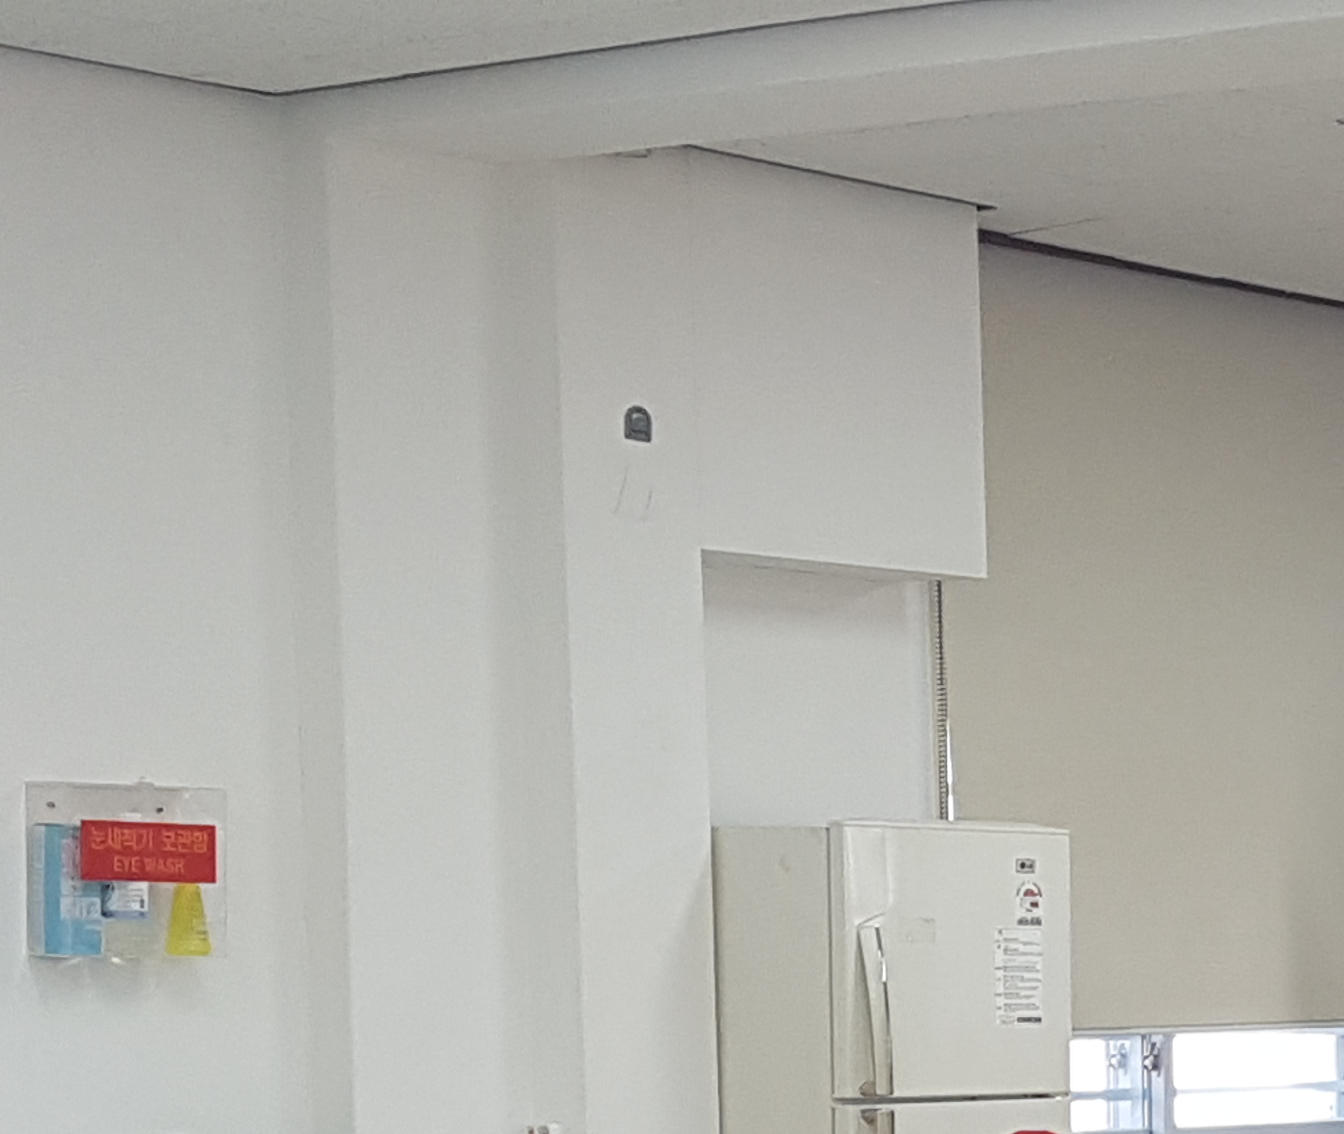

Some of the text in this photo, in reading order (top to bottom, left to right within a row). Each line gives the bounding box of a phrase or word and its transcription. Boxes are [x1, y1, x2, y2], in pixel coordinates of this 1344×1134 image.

[90, 826, 209, 853] 눈세척기 보관함
[113, 855, 185, 874] EYE WASH
